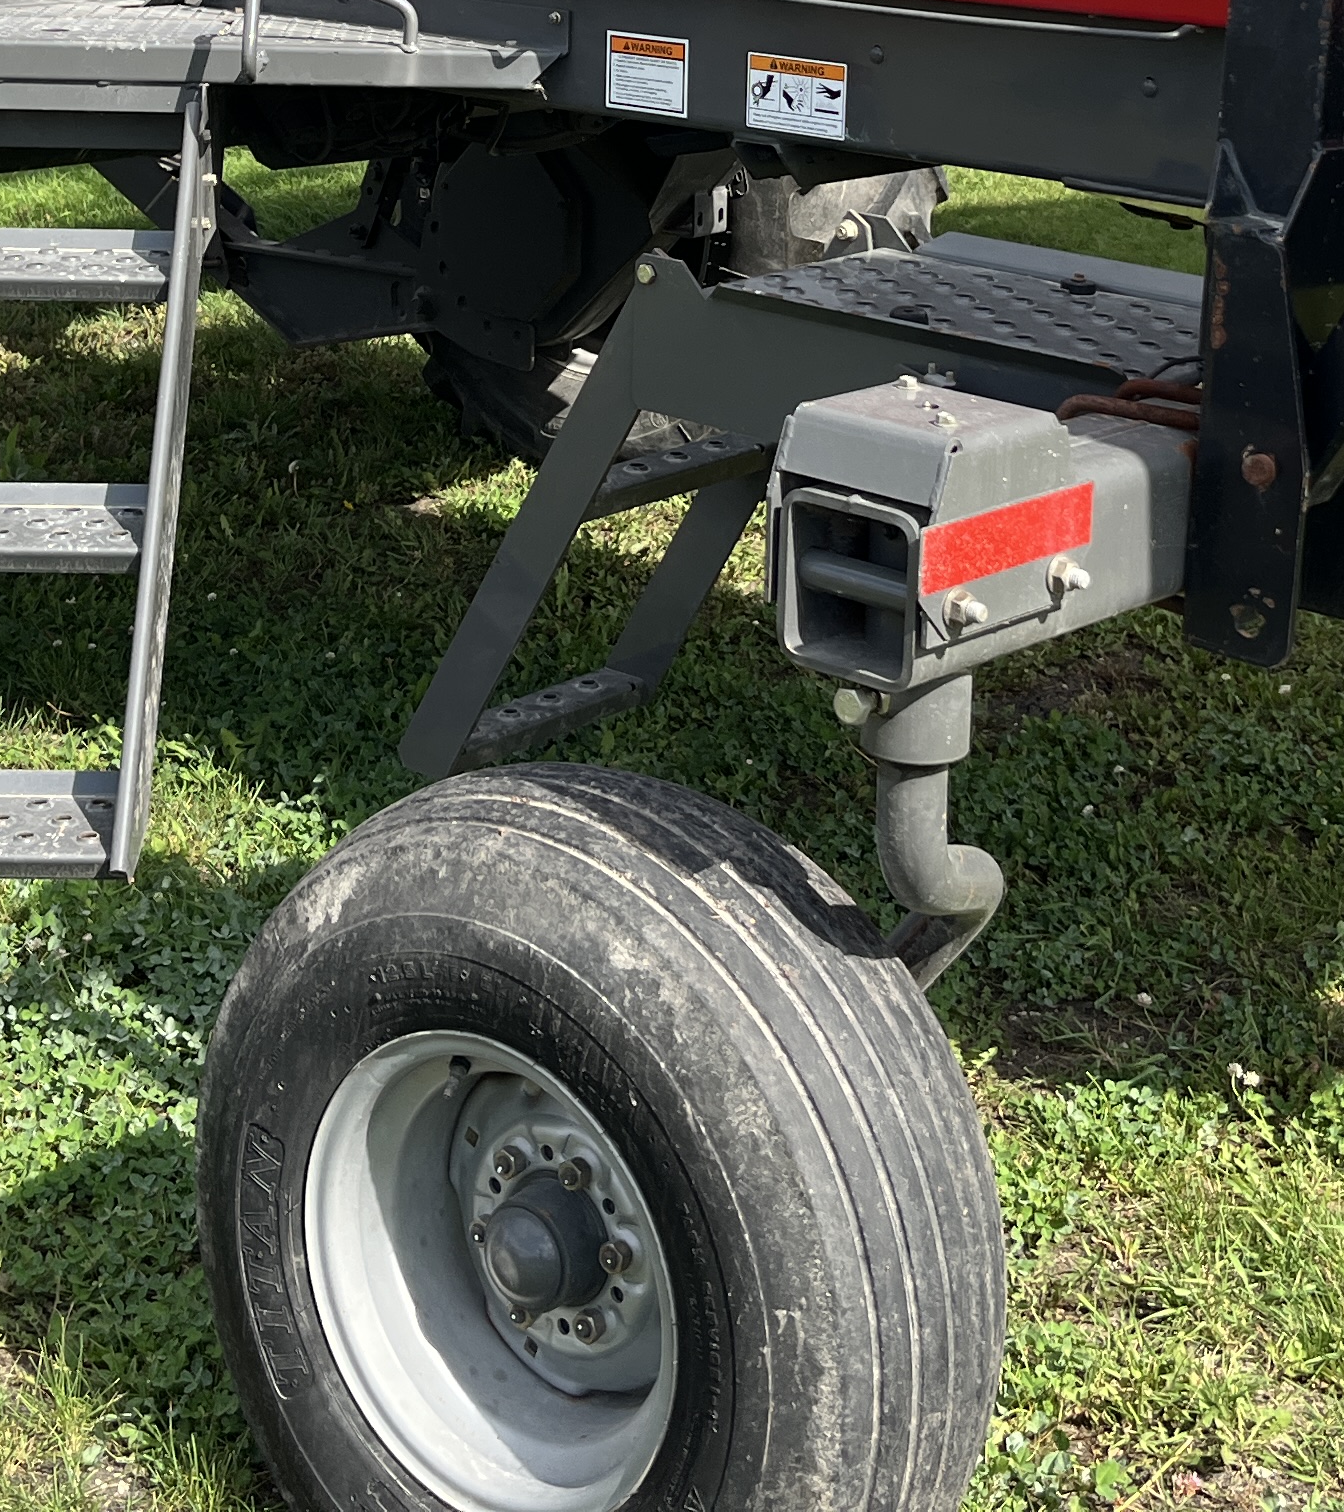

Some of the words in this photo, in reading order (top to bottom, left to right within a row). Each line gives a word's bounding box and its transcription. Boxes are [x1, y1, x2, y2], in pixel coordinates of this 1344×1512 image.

[631, 41, 673, 56] WARNING
[779, 61, 825, 76] WARNING
[240, 1130, 310, 1386] TITAN
